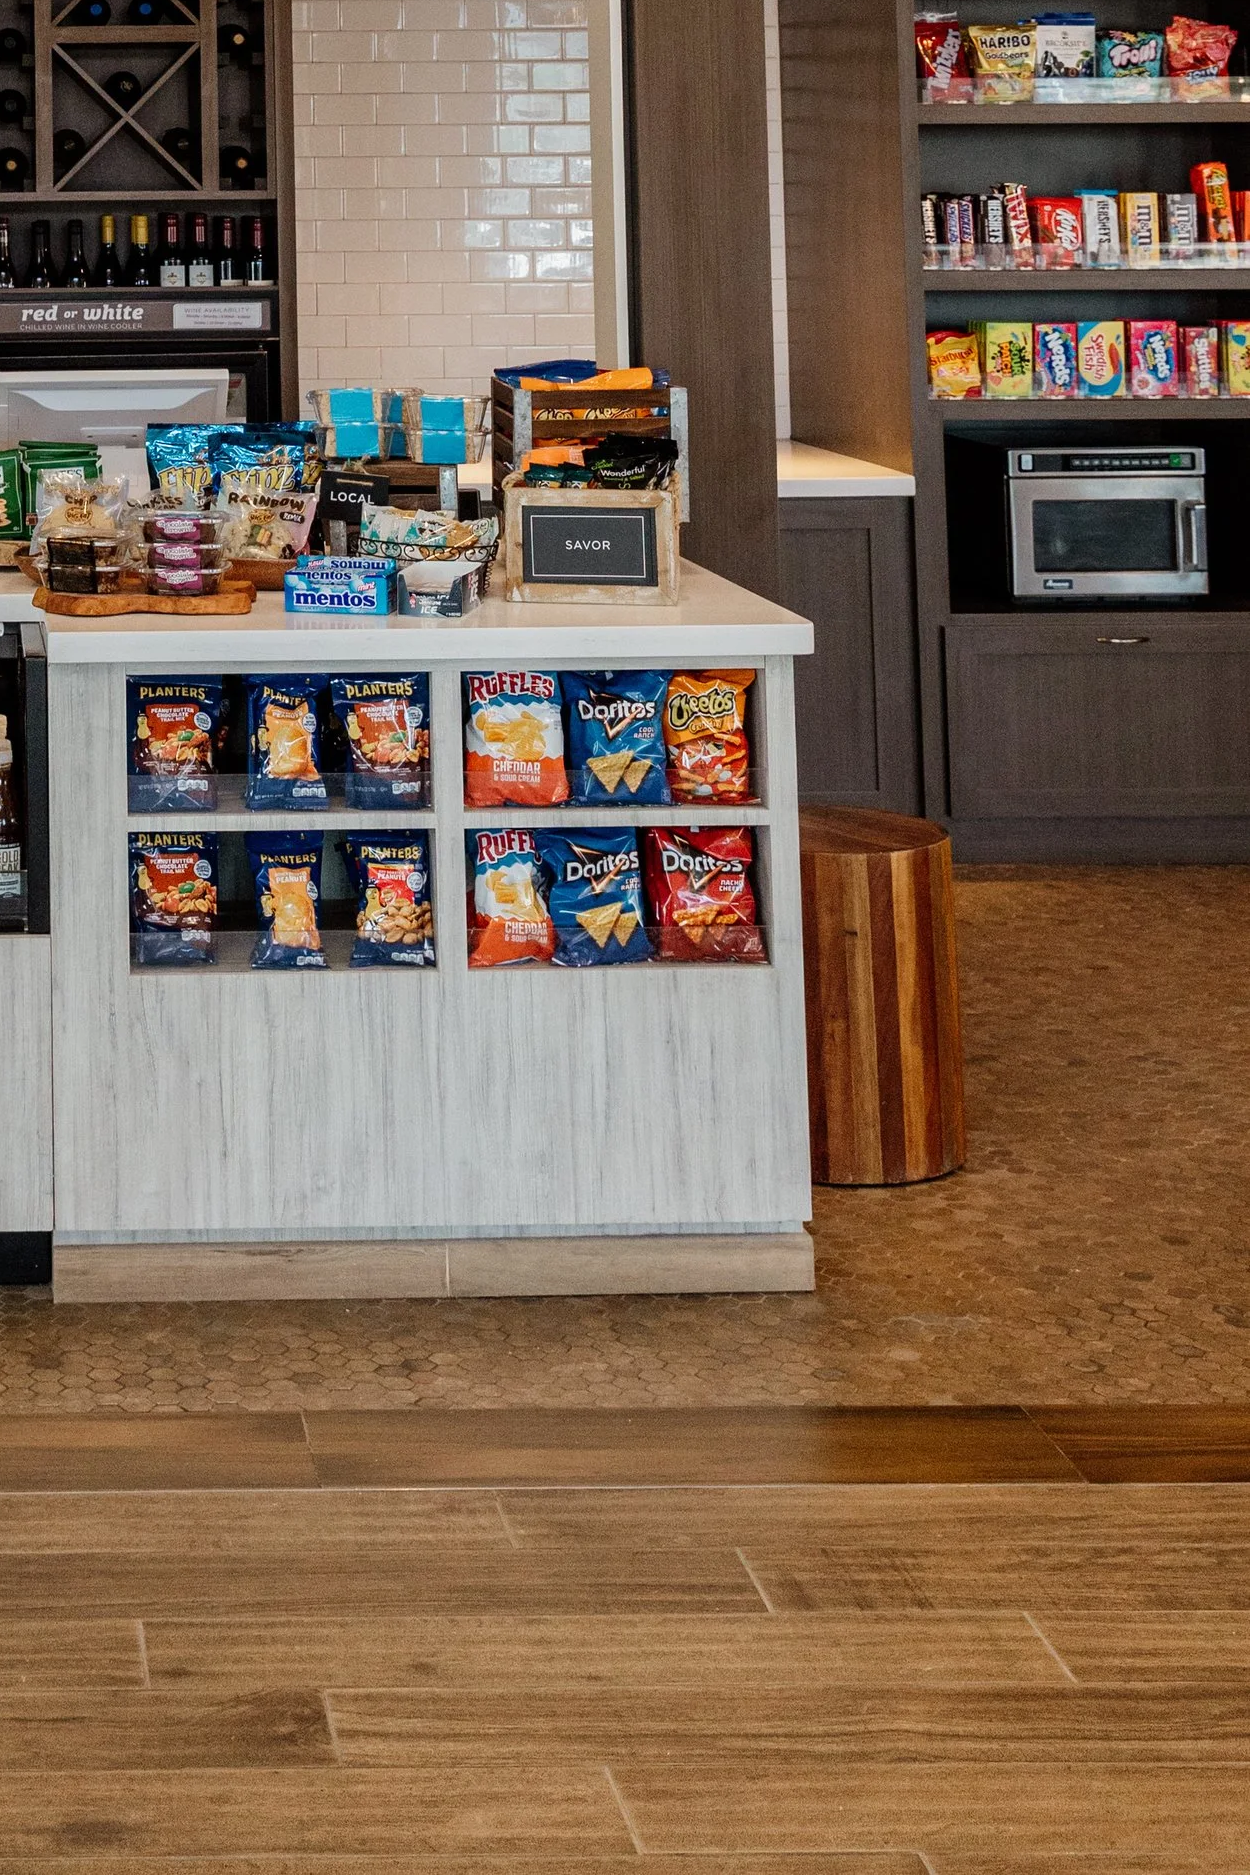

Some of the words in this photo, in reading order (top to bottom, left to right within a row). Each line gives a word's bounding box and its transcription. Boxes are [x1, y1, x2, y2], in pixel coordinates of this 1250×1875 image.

[980, 35, 1031, 49] HARIBO
[1110, 40, 1157, 67] Trolli
[21, 304, 58, 322] red
[64, 310, 78, 319] or
[83, 303, 144, 321] white
[55, 323, 75, 331] WINE
[930, 348, 974, 366] Starburst
[1091, 334, 1107, 380] Swedish
[600, 465, 645, 477] Wonderful
[65, 495, 97, 506] CHIP
[228, 492, 306, 514] RAINBOW
[330, 491, 375, 505] LOCAL
[565, 540, 611, 551] SAVOR
[357, 581, 376, 592] mint
[295, 591, 376, 607] mentos
[420, 606, 438, 614] ICE
[140, 686, 206, 700] PLANTERS
[346, 681, 413, 699] PLANTERS
[468, 672, 555, 703] RUFFLES
[263, 686, 307, 706] PLANTE
[578, 699, 656, 720] Doritos
[669, 689, 736, 729] Cheetos
[493, 760, 541, 774] CHEDDAR
[493, 773, 499, 781] &
[500, 774, 518, 782] SOUR
[518, 774, 541, 783] CREAM
[138, 834, 203, 846] PLANTERS
[361, 846, 420, 859] PLANTERS
[477, 830, 535, 865] RUFF
[260, 852, 317, 865] PLANTERS
[662, 850, 743, 872] Doritos
[566, 851, 640, 882] Doritos
[377, 873, 406, 881] PEANUTS
[505, 921, 548, 934] CHEDDAR
[511, 935, 528, 943] SOUR
